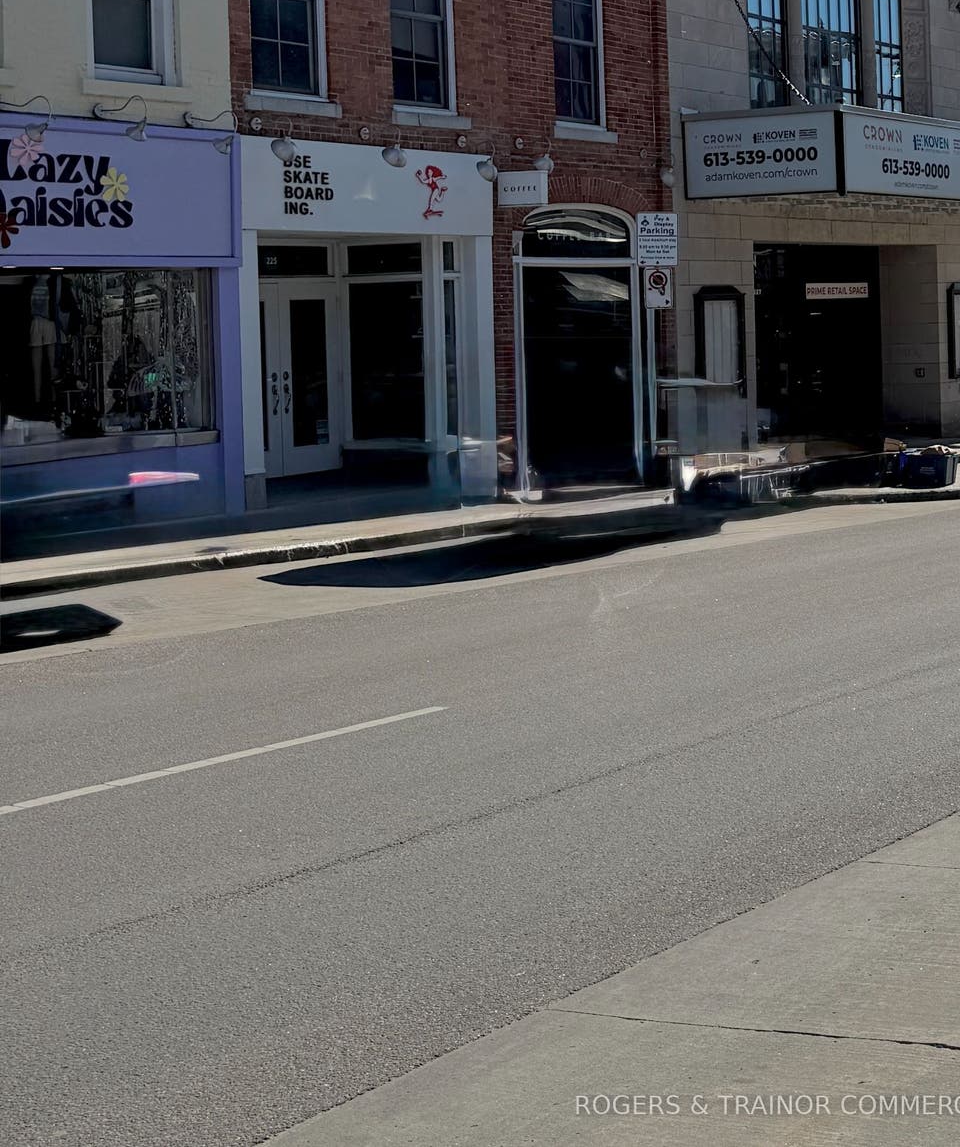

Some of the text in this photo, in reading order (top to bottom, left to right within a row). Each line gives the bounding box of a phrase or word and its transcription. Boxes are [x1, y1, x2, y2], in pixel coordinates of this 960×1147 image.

[703, 134, 742, 144] CROWN
[765, 130, 796, 140] KOVEN
[863, 125, 903, 143] CROWN
[923, 135, 950, 150] KOVEN
[703, 146, 818, 167] 613-539-0000
[0, 139, 110, 196] Lazy
[705, 167, 818, 182] adamkoven.com/crown
[881, 158, 950, 179] 613-539-0000
[283, 170, 330, 185] SKATE
[284, 185, 334, 201] BOARD
[0, 186, 134, 229] aisies
[284, 201, 314, 215] ING.
[640, 227, 674, 235] Parking
[807, 286, 867, 295] PRIME RETAIL SPACE
